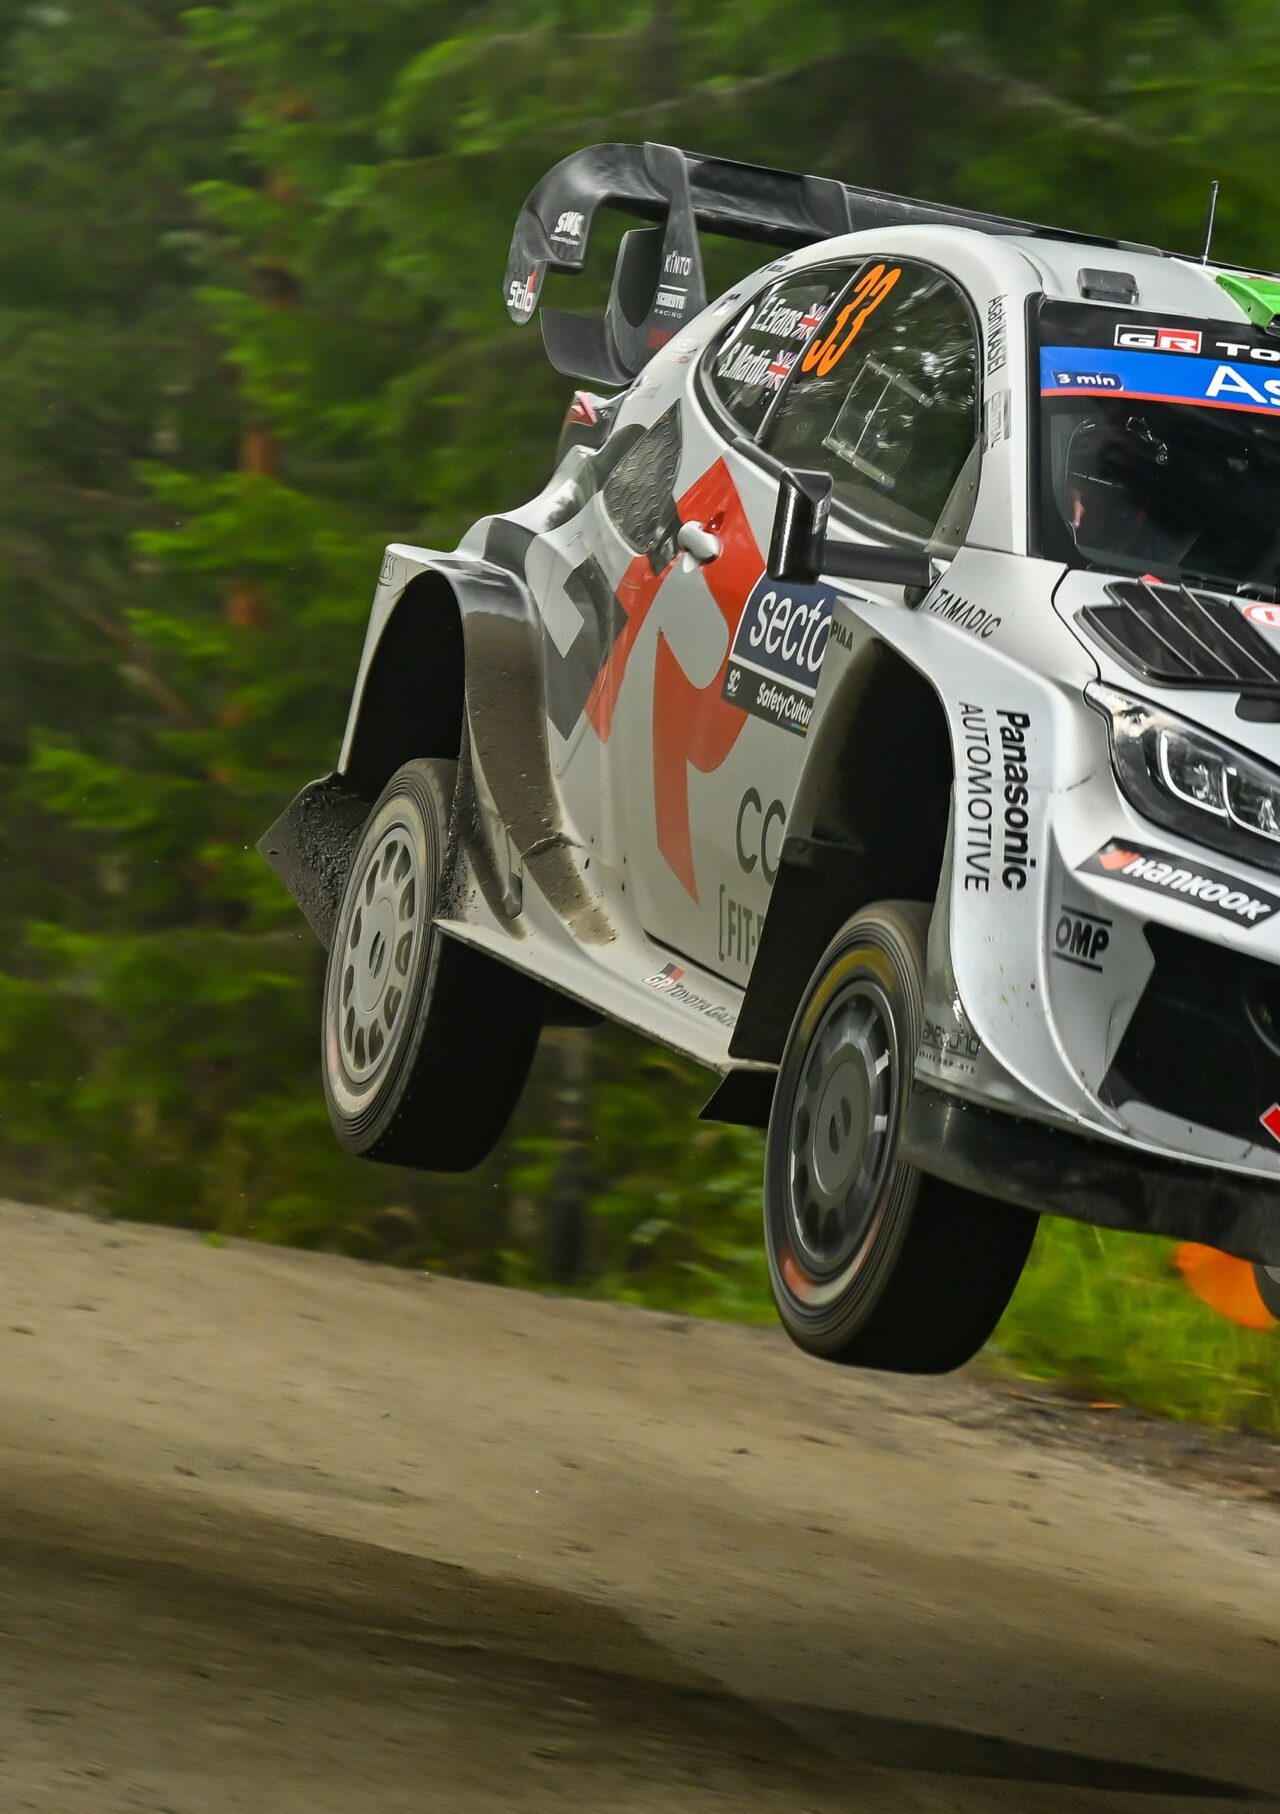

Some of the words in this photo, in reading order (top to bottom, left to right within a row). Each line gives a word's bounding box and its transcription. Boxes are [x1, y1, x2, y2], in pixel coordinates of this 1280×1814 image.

[507, 272, 536, 312] Stilo
[653, 308, 684, 319] RACING
[802, 264, 902, 377] 33
[1116, 326, 1201, 353] GR
[1057, 373, 1071, 385] 3
[1076, 375, 1115, 388] min
[930, 588, 1002, 639] TAMADIC
[958, 701, 993, 893] AUTOMOTIVE
[996, 708, 1037, 891] Panasonic
[1054, 908, 1113, 970] OMP
